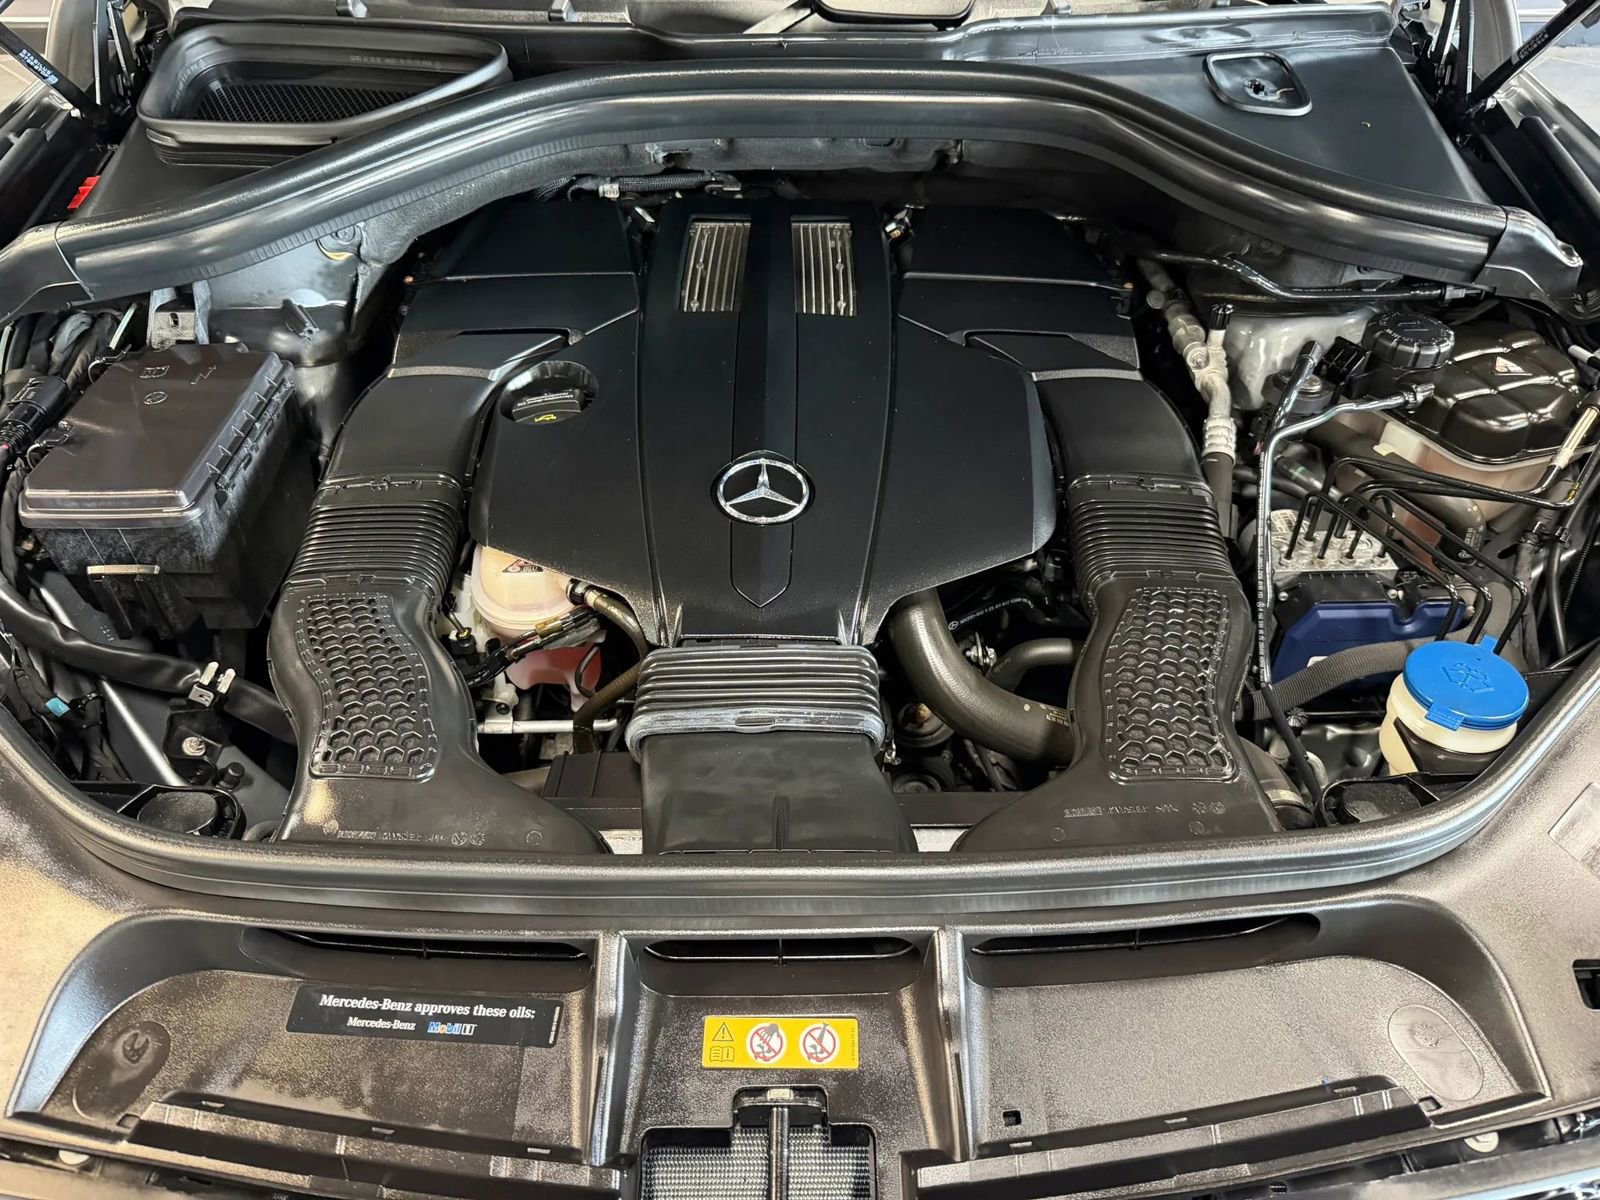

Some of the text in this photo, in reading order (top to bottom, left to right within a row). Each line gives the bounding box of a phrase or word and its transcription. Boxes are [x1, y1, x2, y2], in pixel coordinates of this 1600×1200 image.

[21, 49, 53, 75] STABILUS
[319, 994, 536, 1019] Mercedes-Benz approves these oils:
[347, 1017, 416, 1030] Mercedes-Benz
[427, 1021, 462, 1034] Mobil
